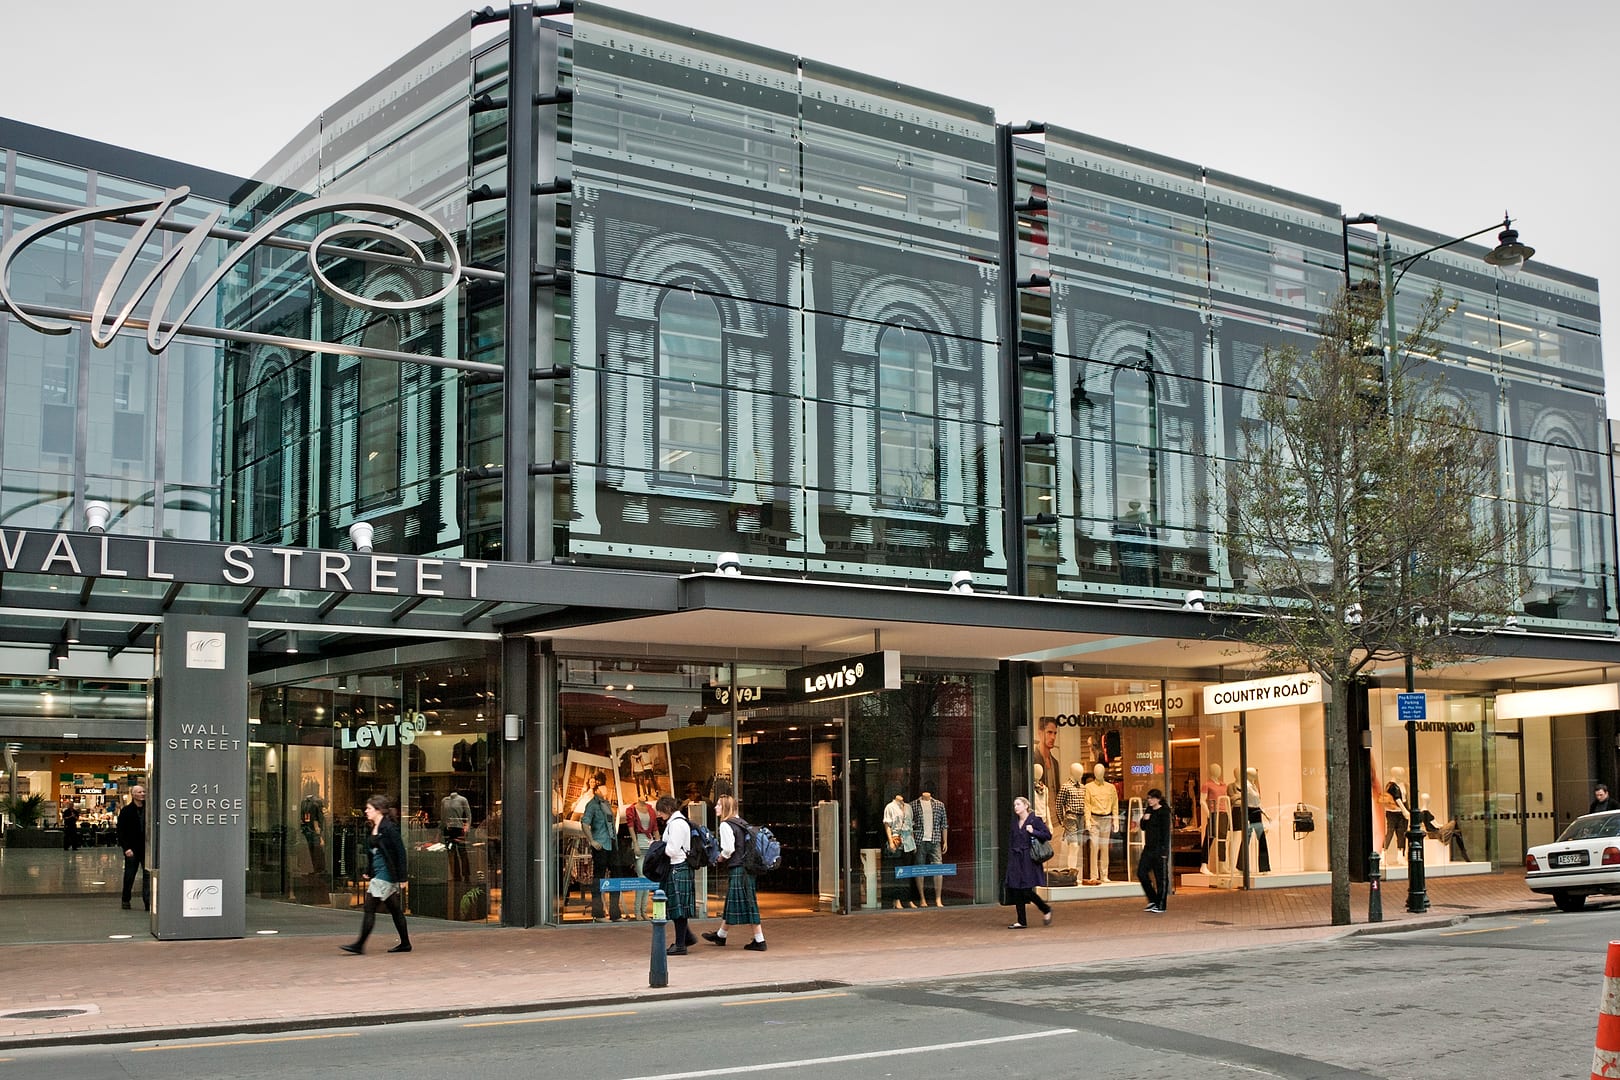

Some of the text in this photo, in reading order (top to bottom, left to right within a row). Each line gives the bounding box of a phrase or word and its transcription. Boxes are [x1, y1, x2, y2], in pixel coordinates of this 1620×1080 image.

[222, 545, 488, 598] STREET
[1213, 682, 1309, 705] COUNTRY ROAD
[1056, 713, 1155, 728] COUNTRY ROAD
[181, 723, 229, 735] WALL
[169, 738, 240, 750] STREET
[190, 784, 220, 794] 211
[165, 798, 242, 810] GEORGE
[167, 813, 240, 825] STREET
